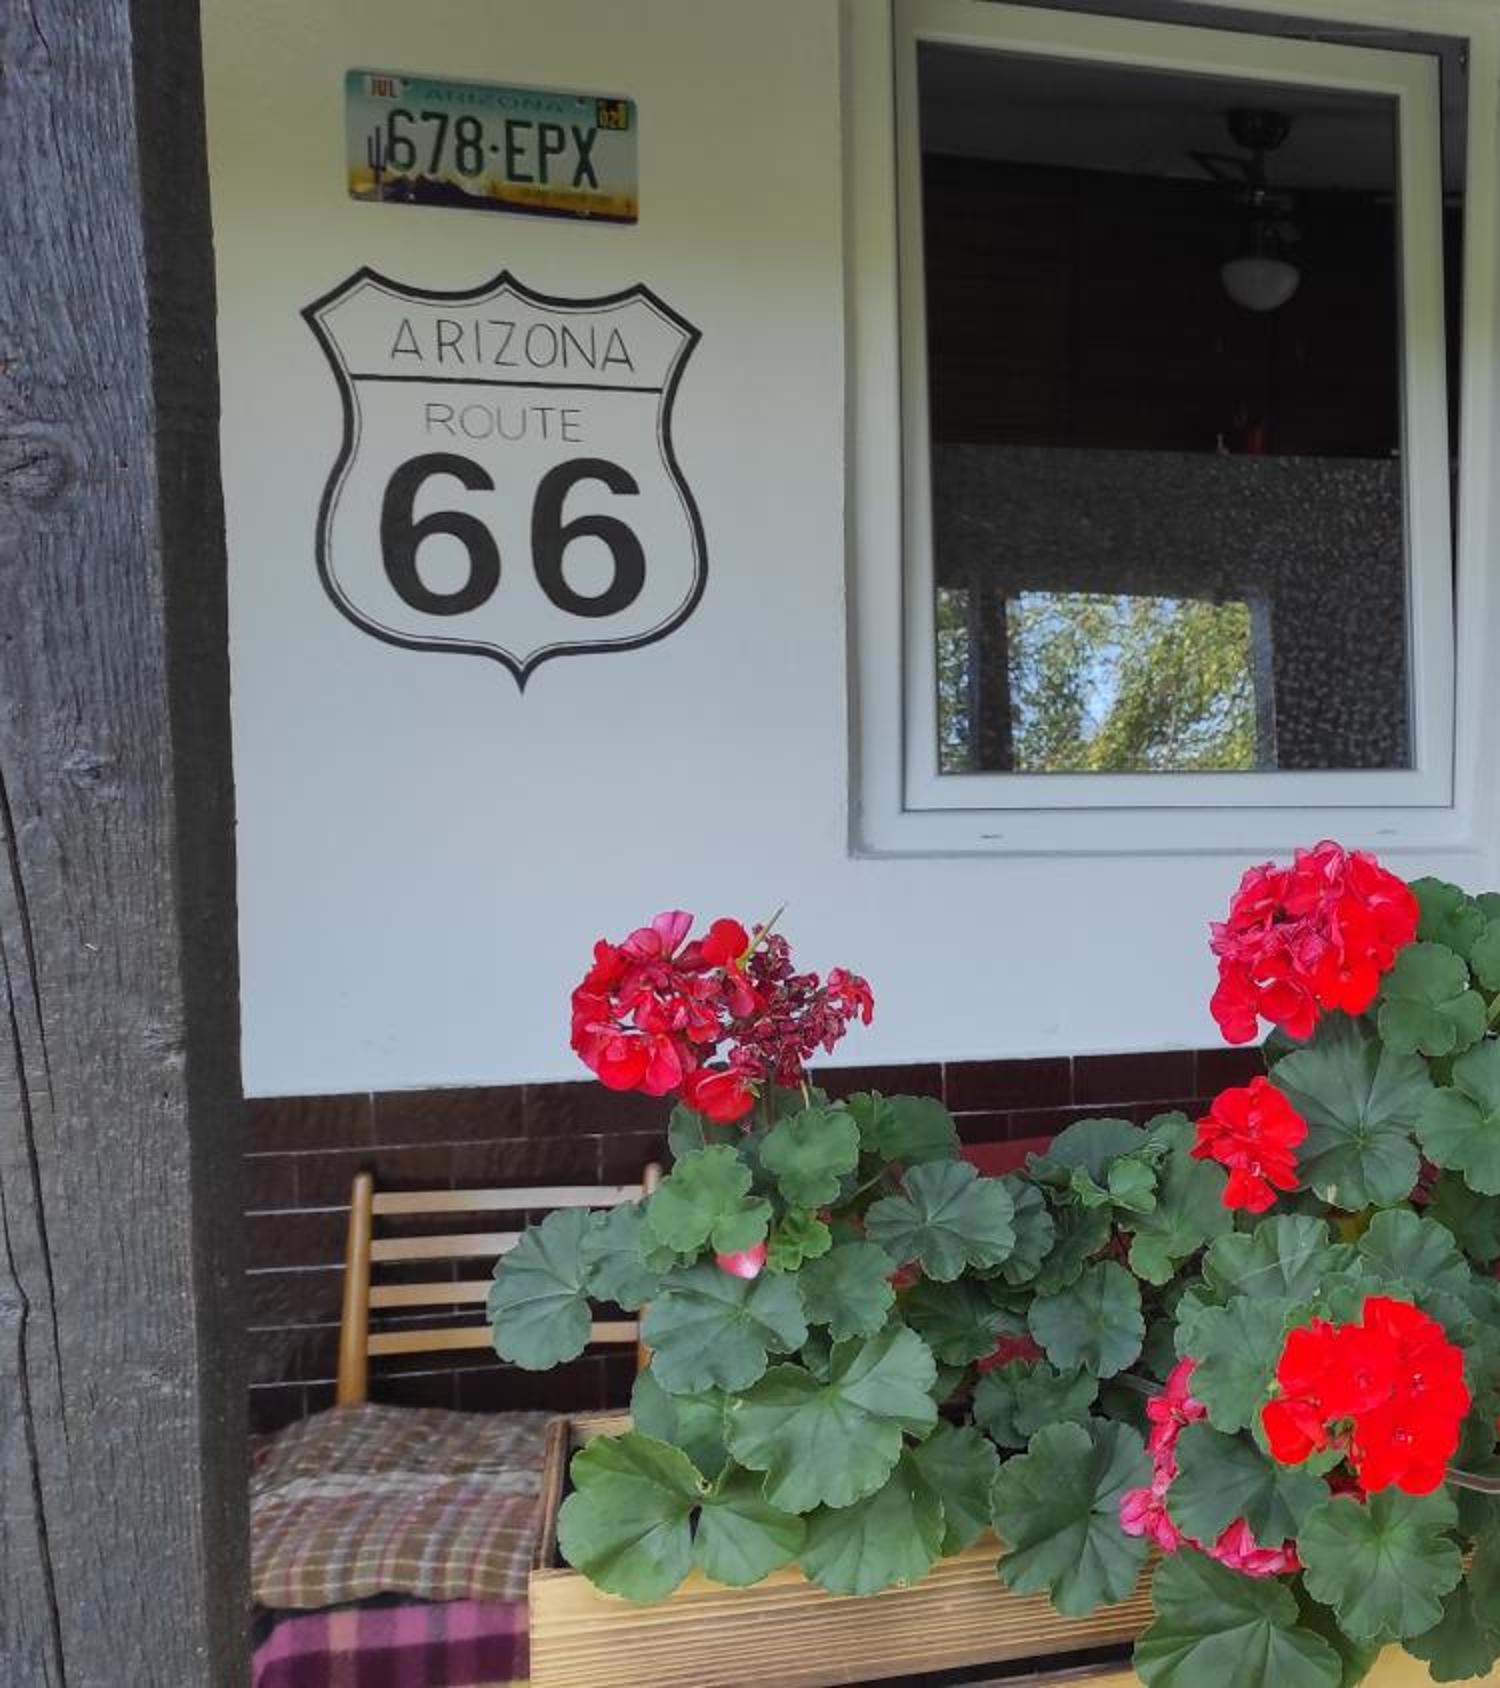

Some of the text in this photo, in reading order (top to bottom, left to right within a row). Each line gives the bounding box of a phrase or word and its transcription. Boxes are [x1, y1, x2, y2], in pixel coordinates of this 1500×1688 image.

[390, 317, 635, 374] ARIZONA
[424, 403, 584, 443] ROUTE
[379, 452, 647, 618] 66
